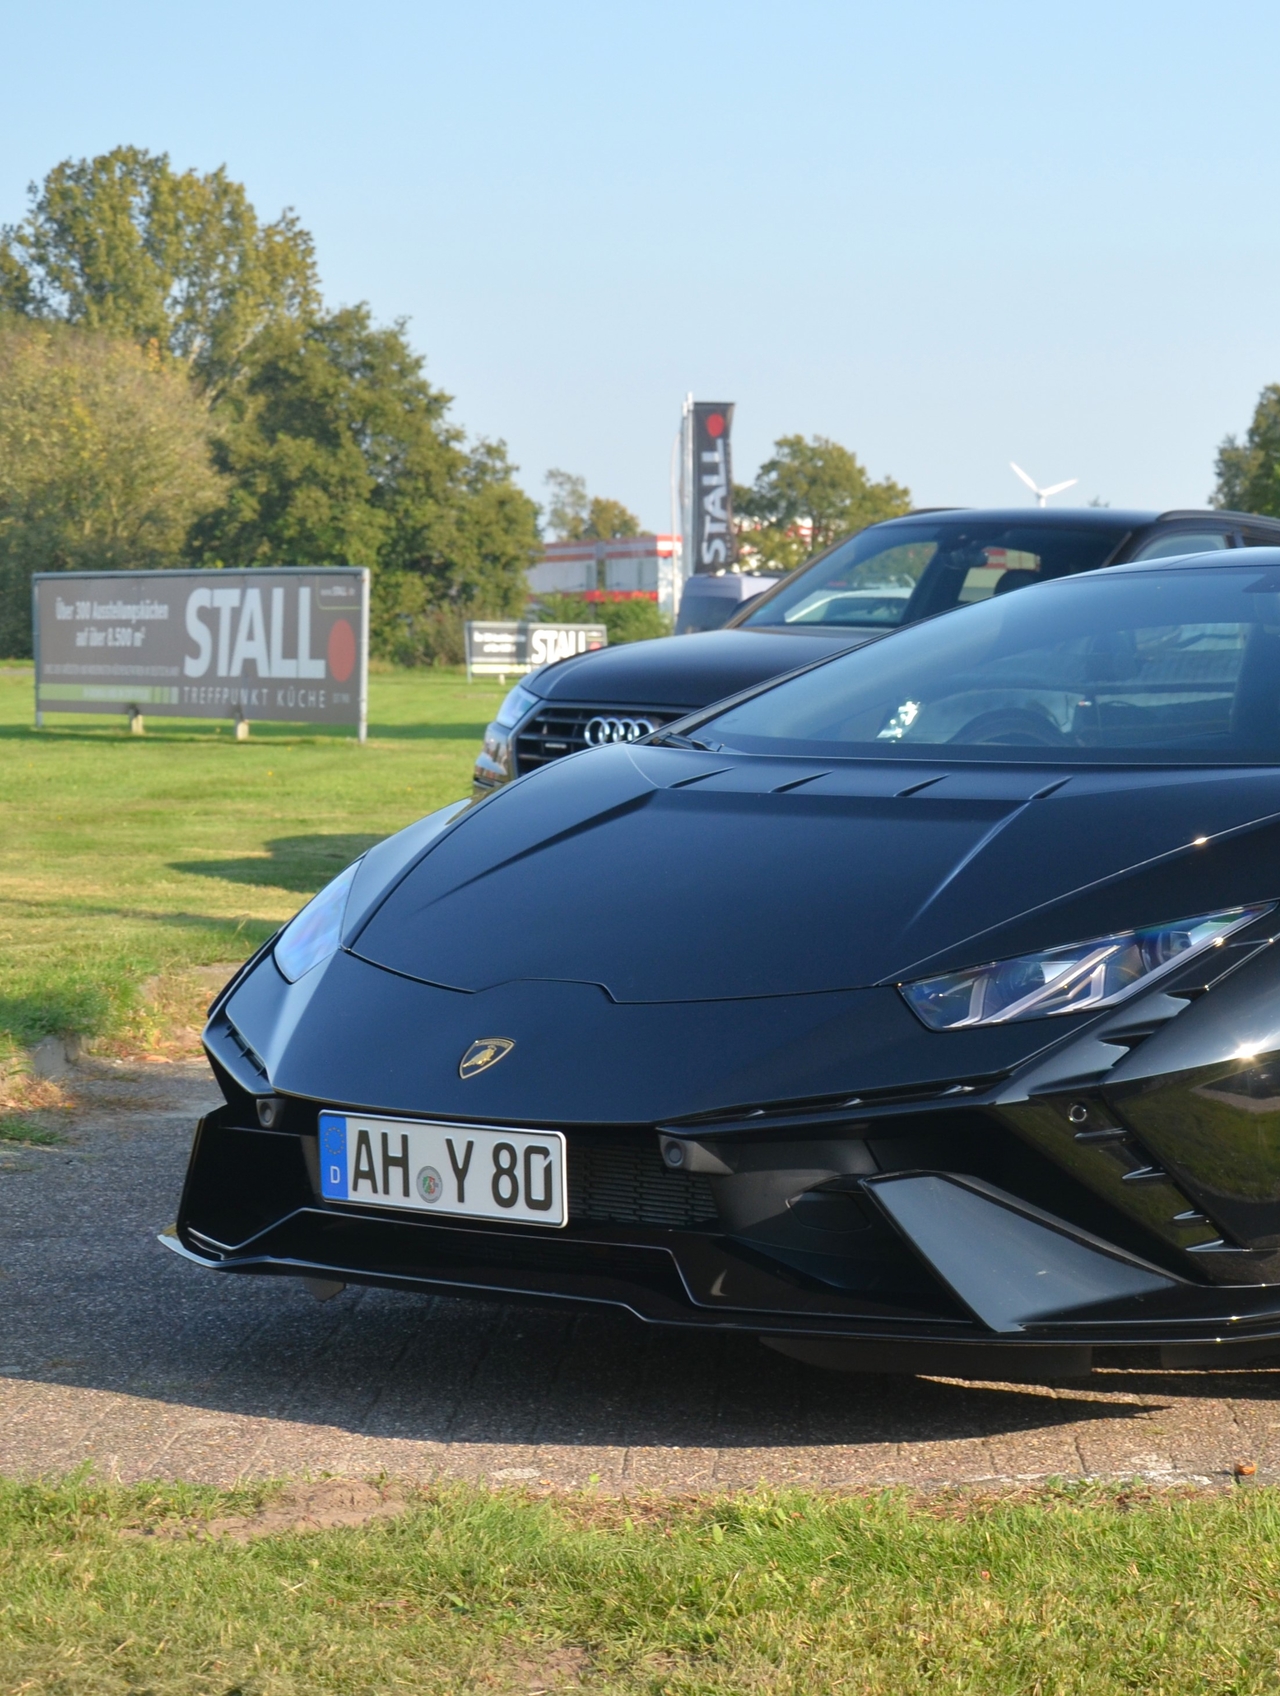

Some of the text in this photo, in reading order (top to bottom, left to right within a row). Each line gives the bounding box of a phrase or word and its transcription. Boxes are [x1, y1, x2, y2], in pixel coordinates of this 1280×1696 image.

[702, 438, 727, 564] STALL
[184, 586, 326, 679] STALL
[183, 686, 269, 705] TREFFPUNKT
[276, 686, 326, 708] KÜCHE
[330, 1166, 341, 1184] D
[352, 1130, 410, 1197] AH
[445, 1138, 474, 1203] Y
[491, 1142, 553, 1211] 80
